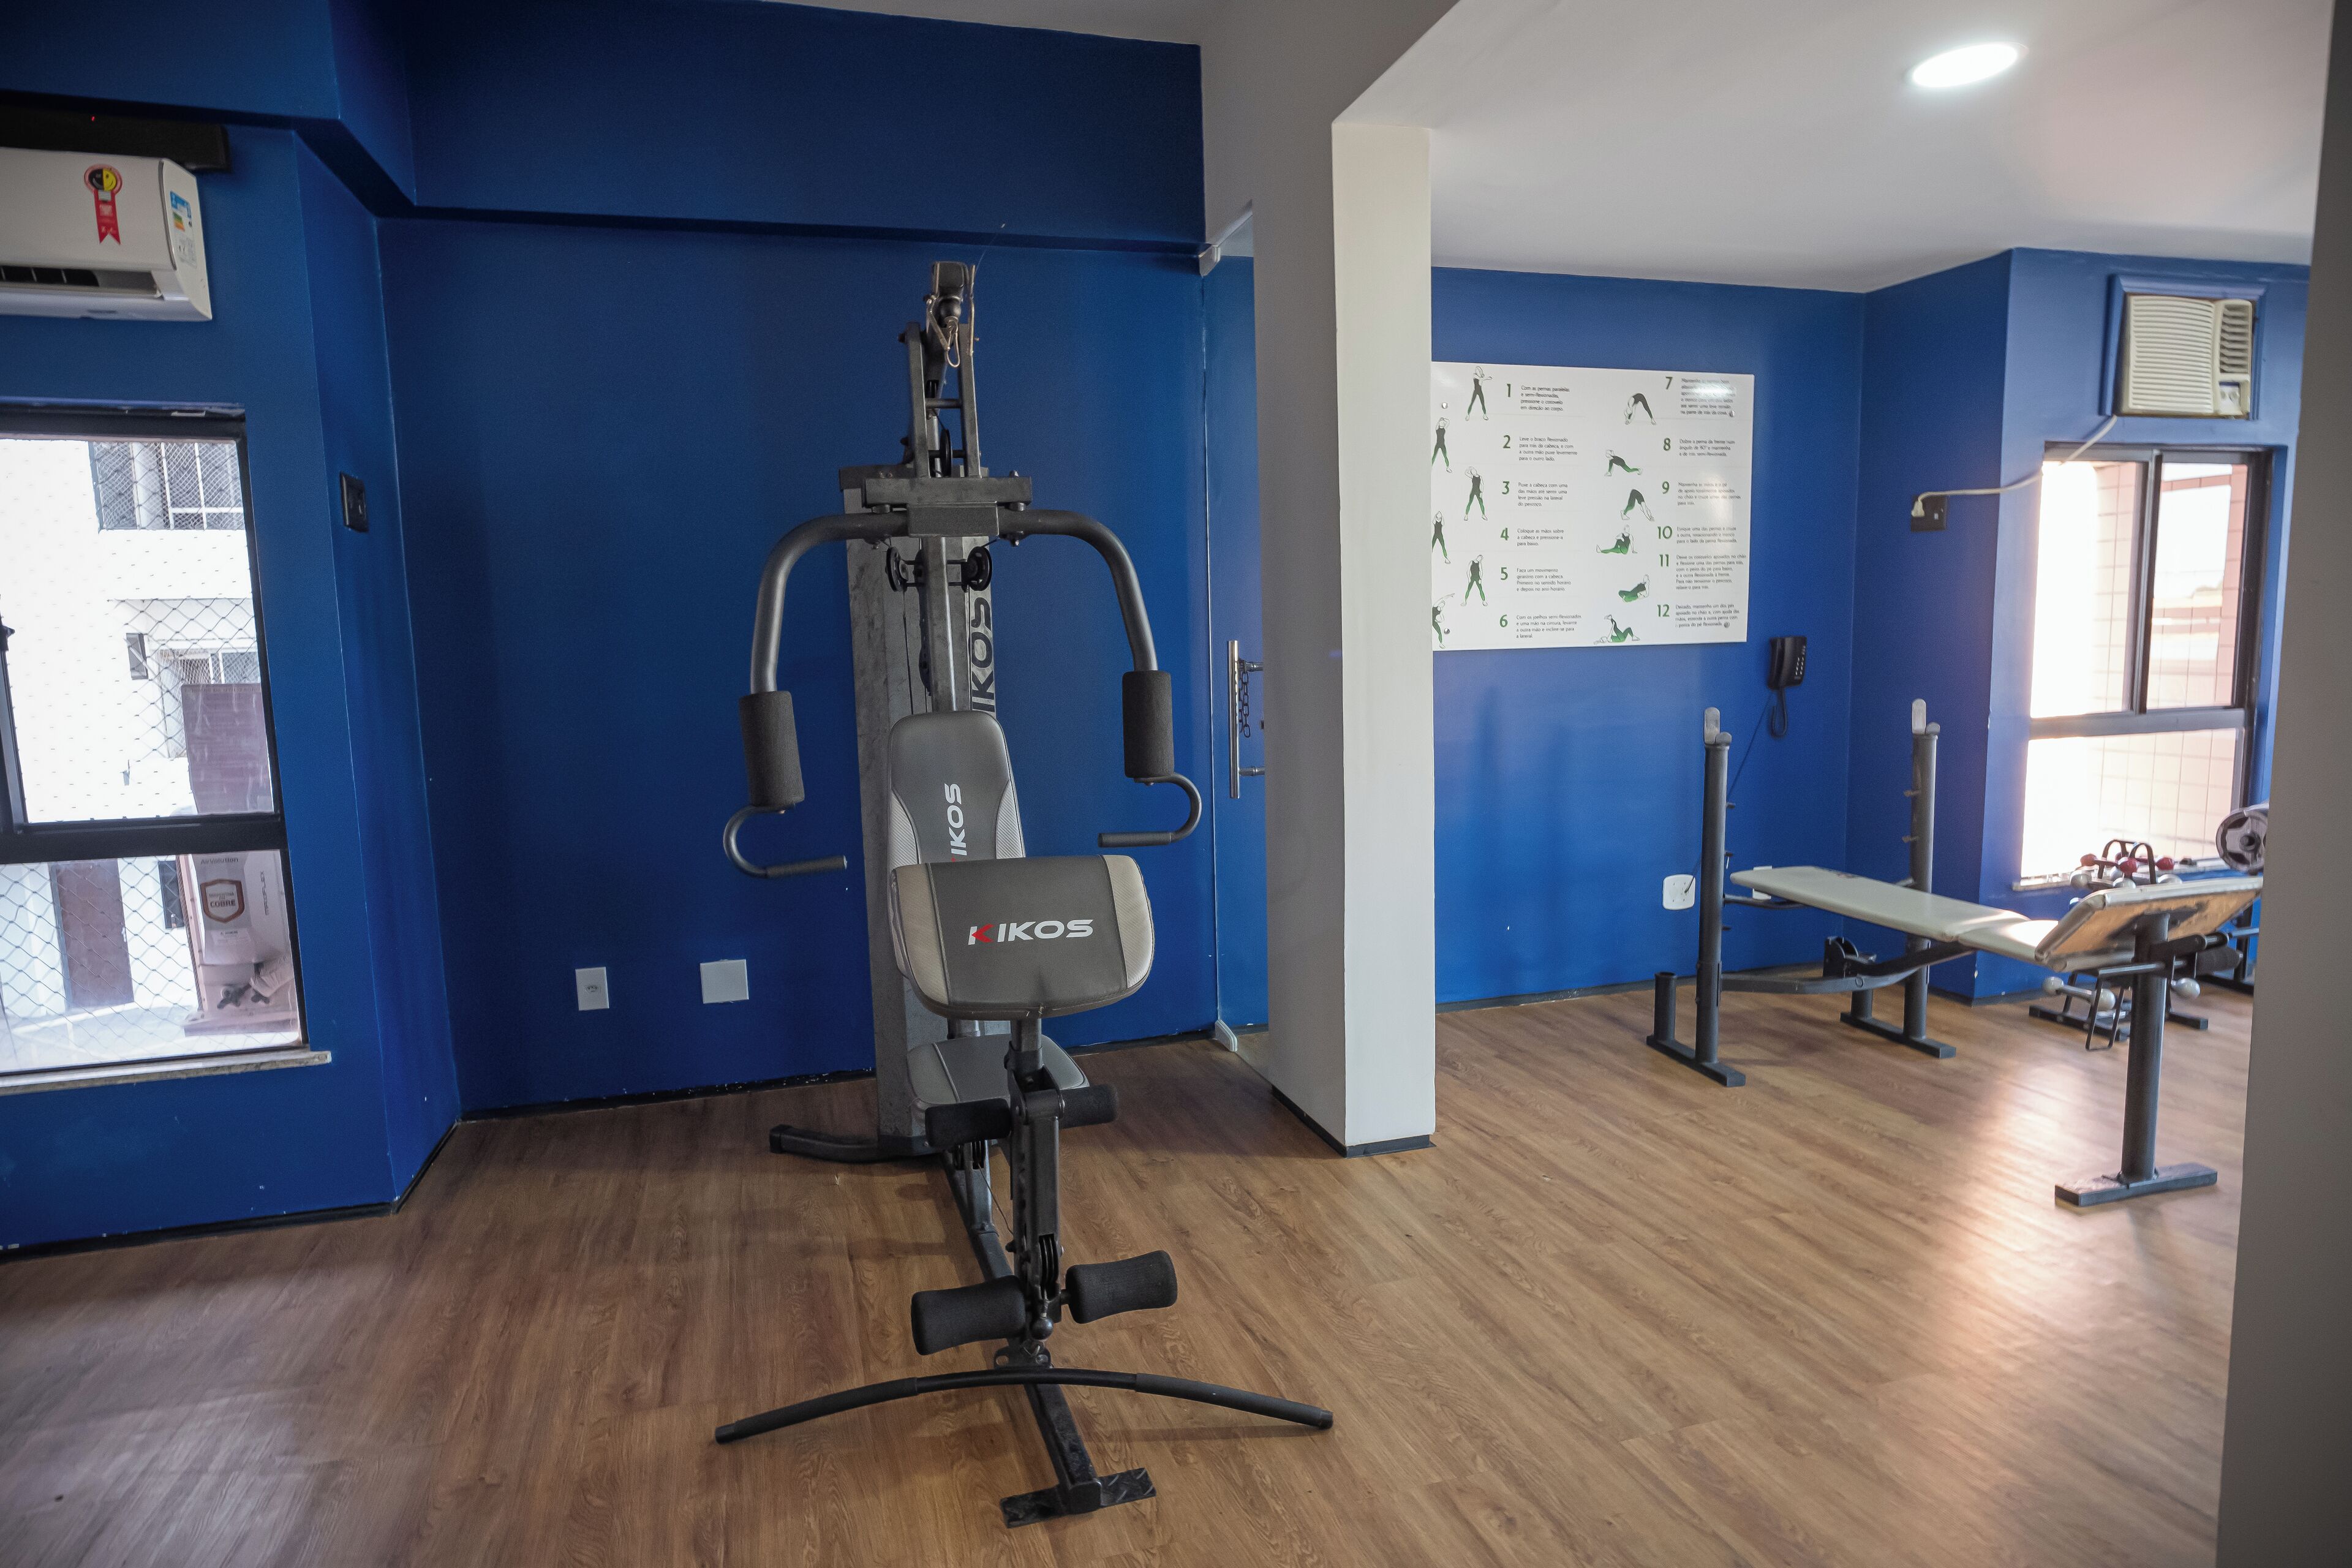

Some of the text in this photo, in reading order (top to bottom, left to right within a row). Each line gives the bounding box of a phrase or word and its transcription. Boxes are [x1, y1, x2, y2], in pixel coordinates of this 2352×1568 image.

[1666, 377, 1672, 389] 7
[1507, 383, 1511, 397] 1
[1503, 435, 1510, 448] 2
[1664, 438, 1671, 451] 8
[1502, 481, 1509, 494] 3
[1662, 481, 1669, 494] 9
[1501, 528, 1509, 540] 4
[1657, 526, 1672, 539] 10
[1660, 554, 1669, 567] 11
[1501, 567, 1508, 580] 5
[1657, 604, 1670, 617] 12
[1500, 614, 1508, 627] 6
[944, 783, 967, 862] IKOS
[968, 919, 1094, 945] KIKOS
